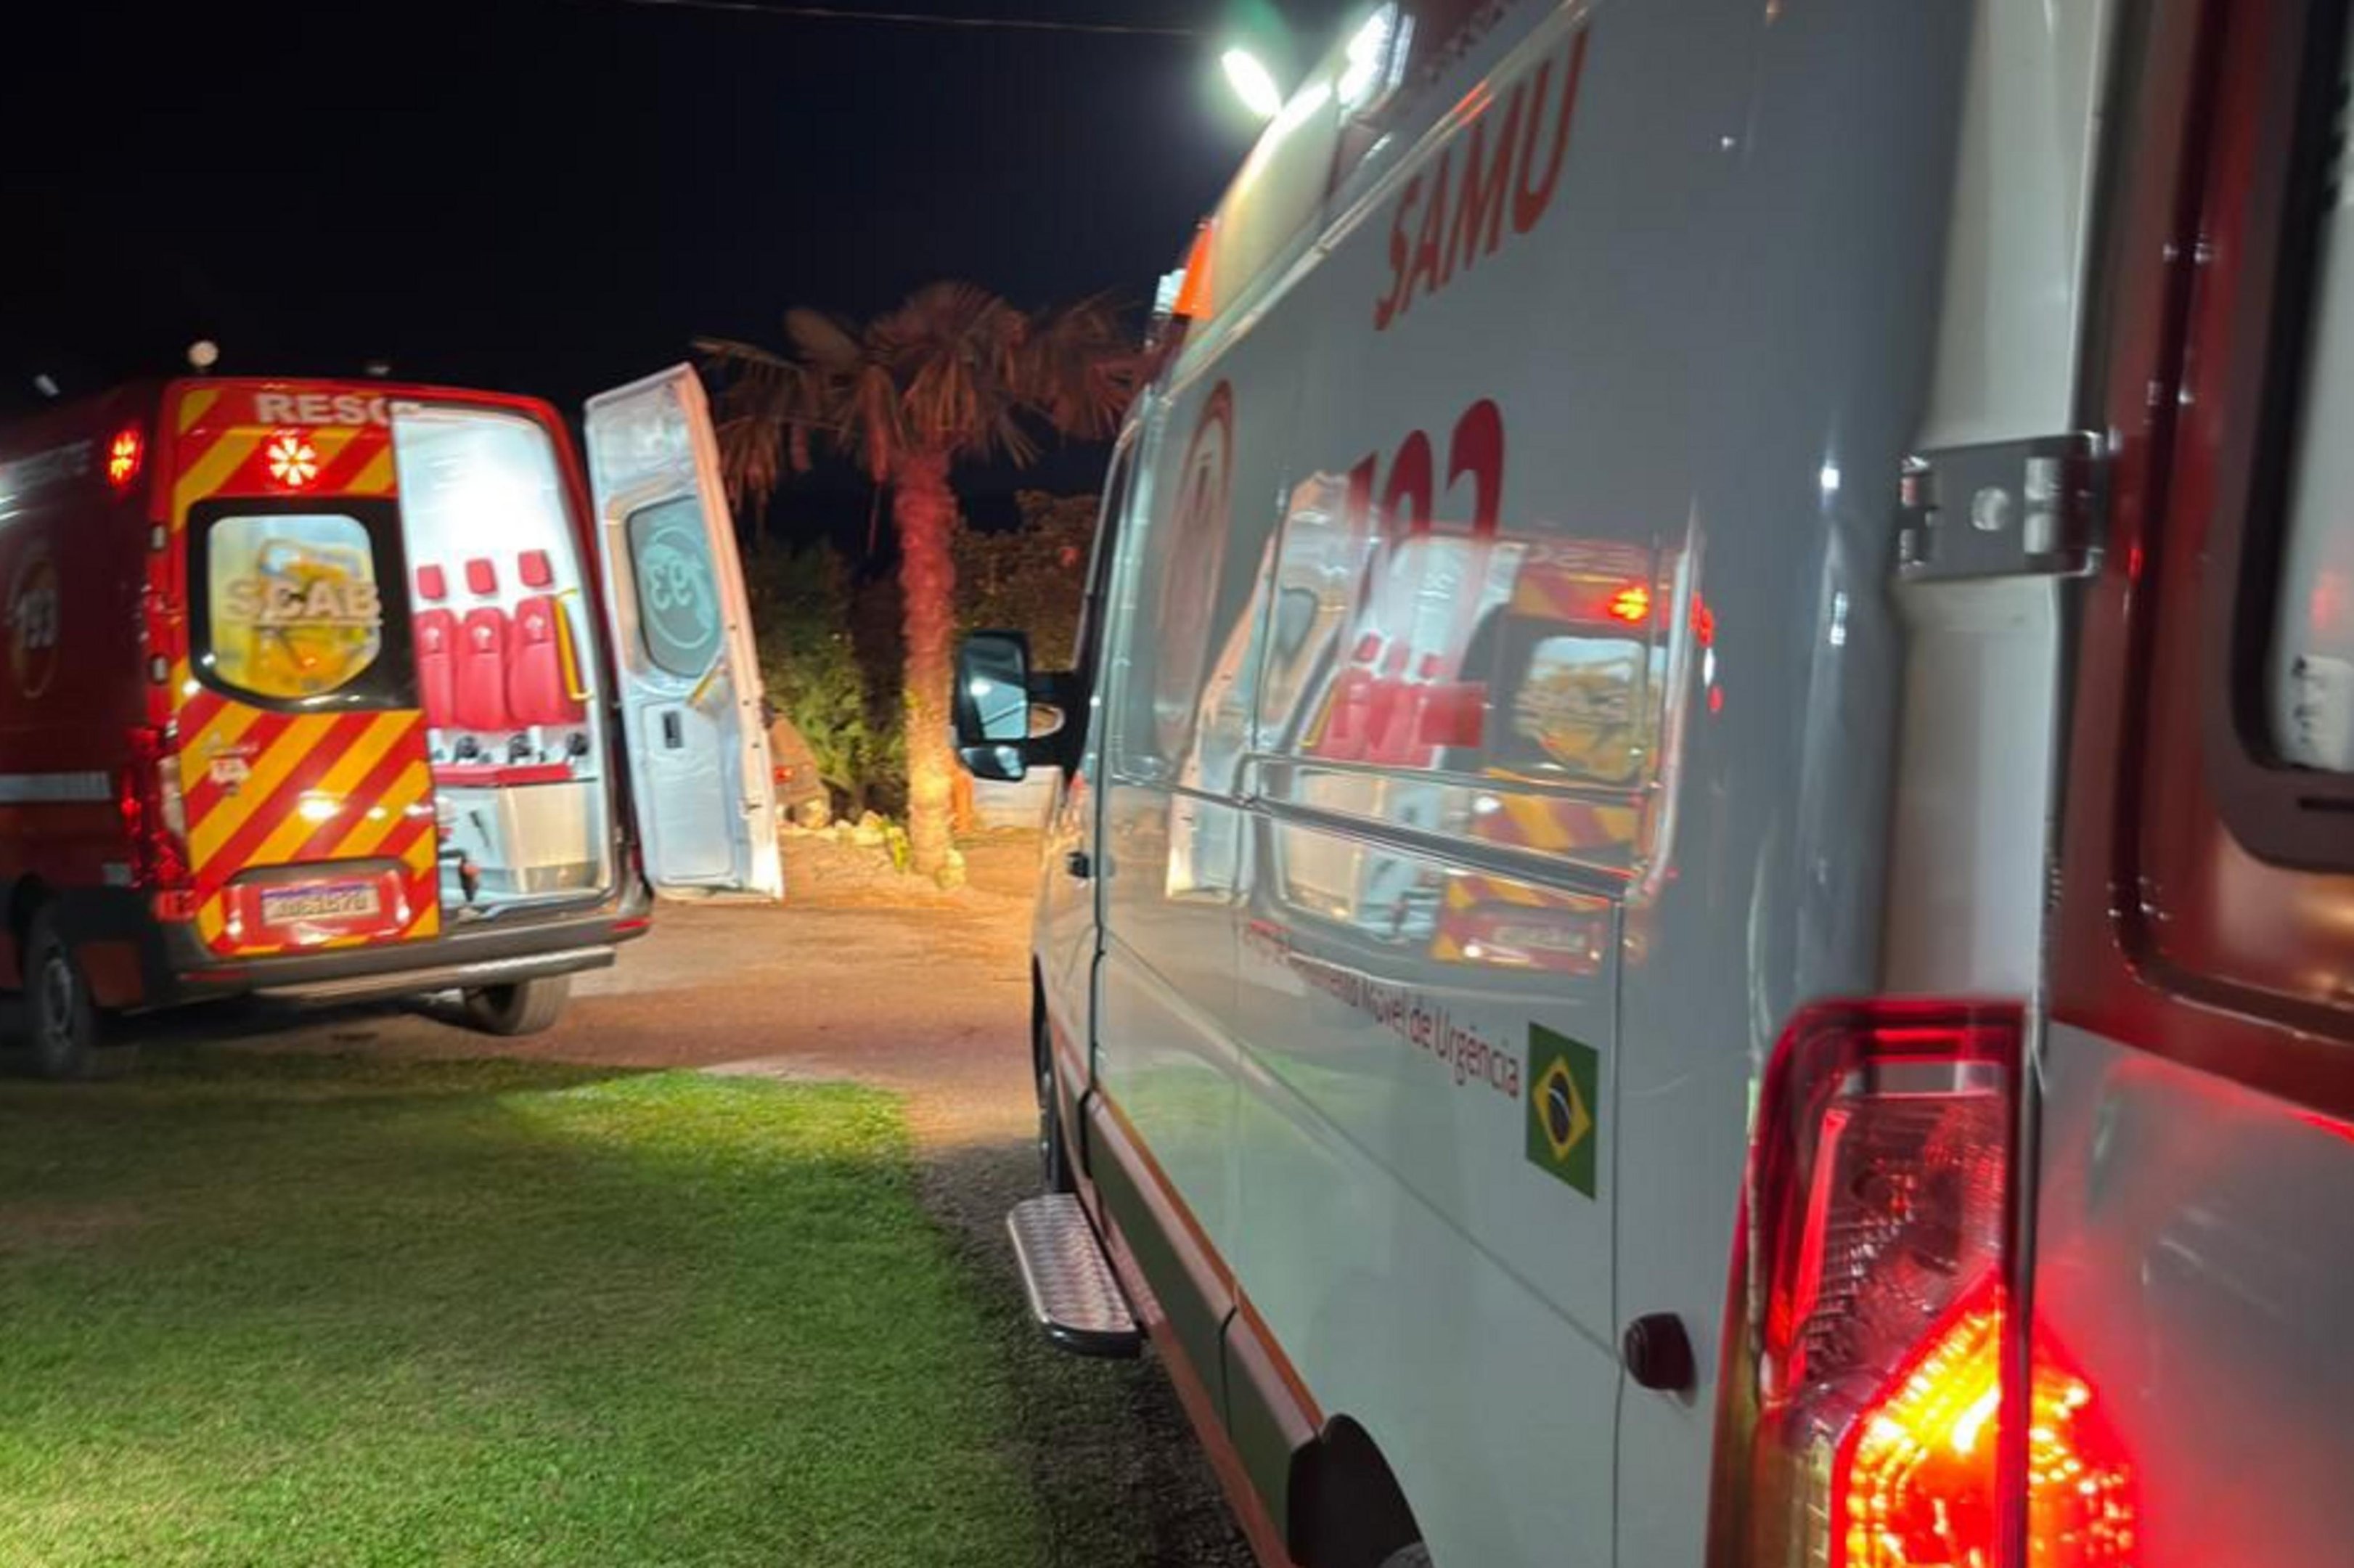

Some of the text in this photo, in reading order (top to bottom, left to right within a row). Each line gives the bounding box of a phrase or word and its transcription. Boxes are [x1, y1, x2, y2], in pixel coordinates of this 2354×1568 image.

[1374, 28, 1590, 331] SAMU
[1410, 993, 1433, 1050] de
[1434, 1005, 1519, 1098] Urgência
